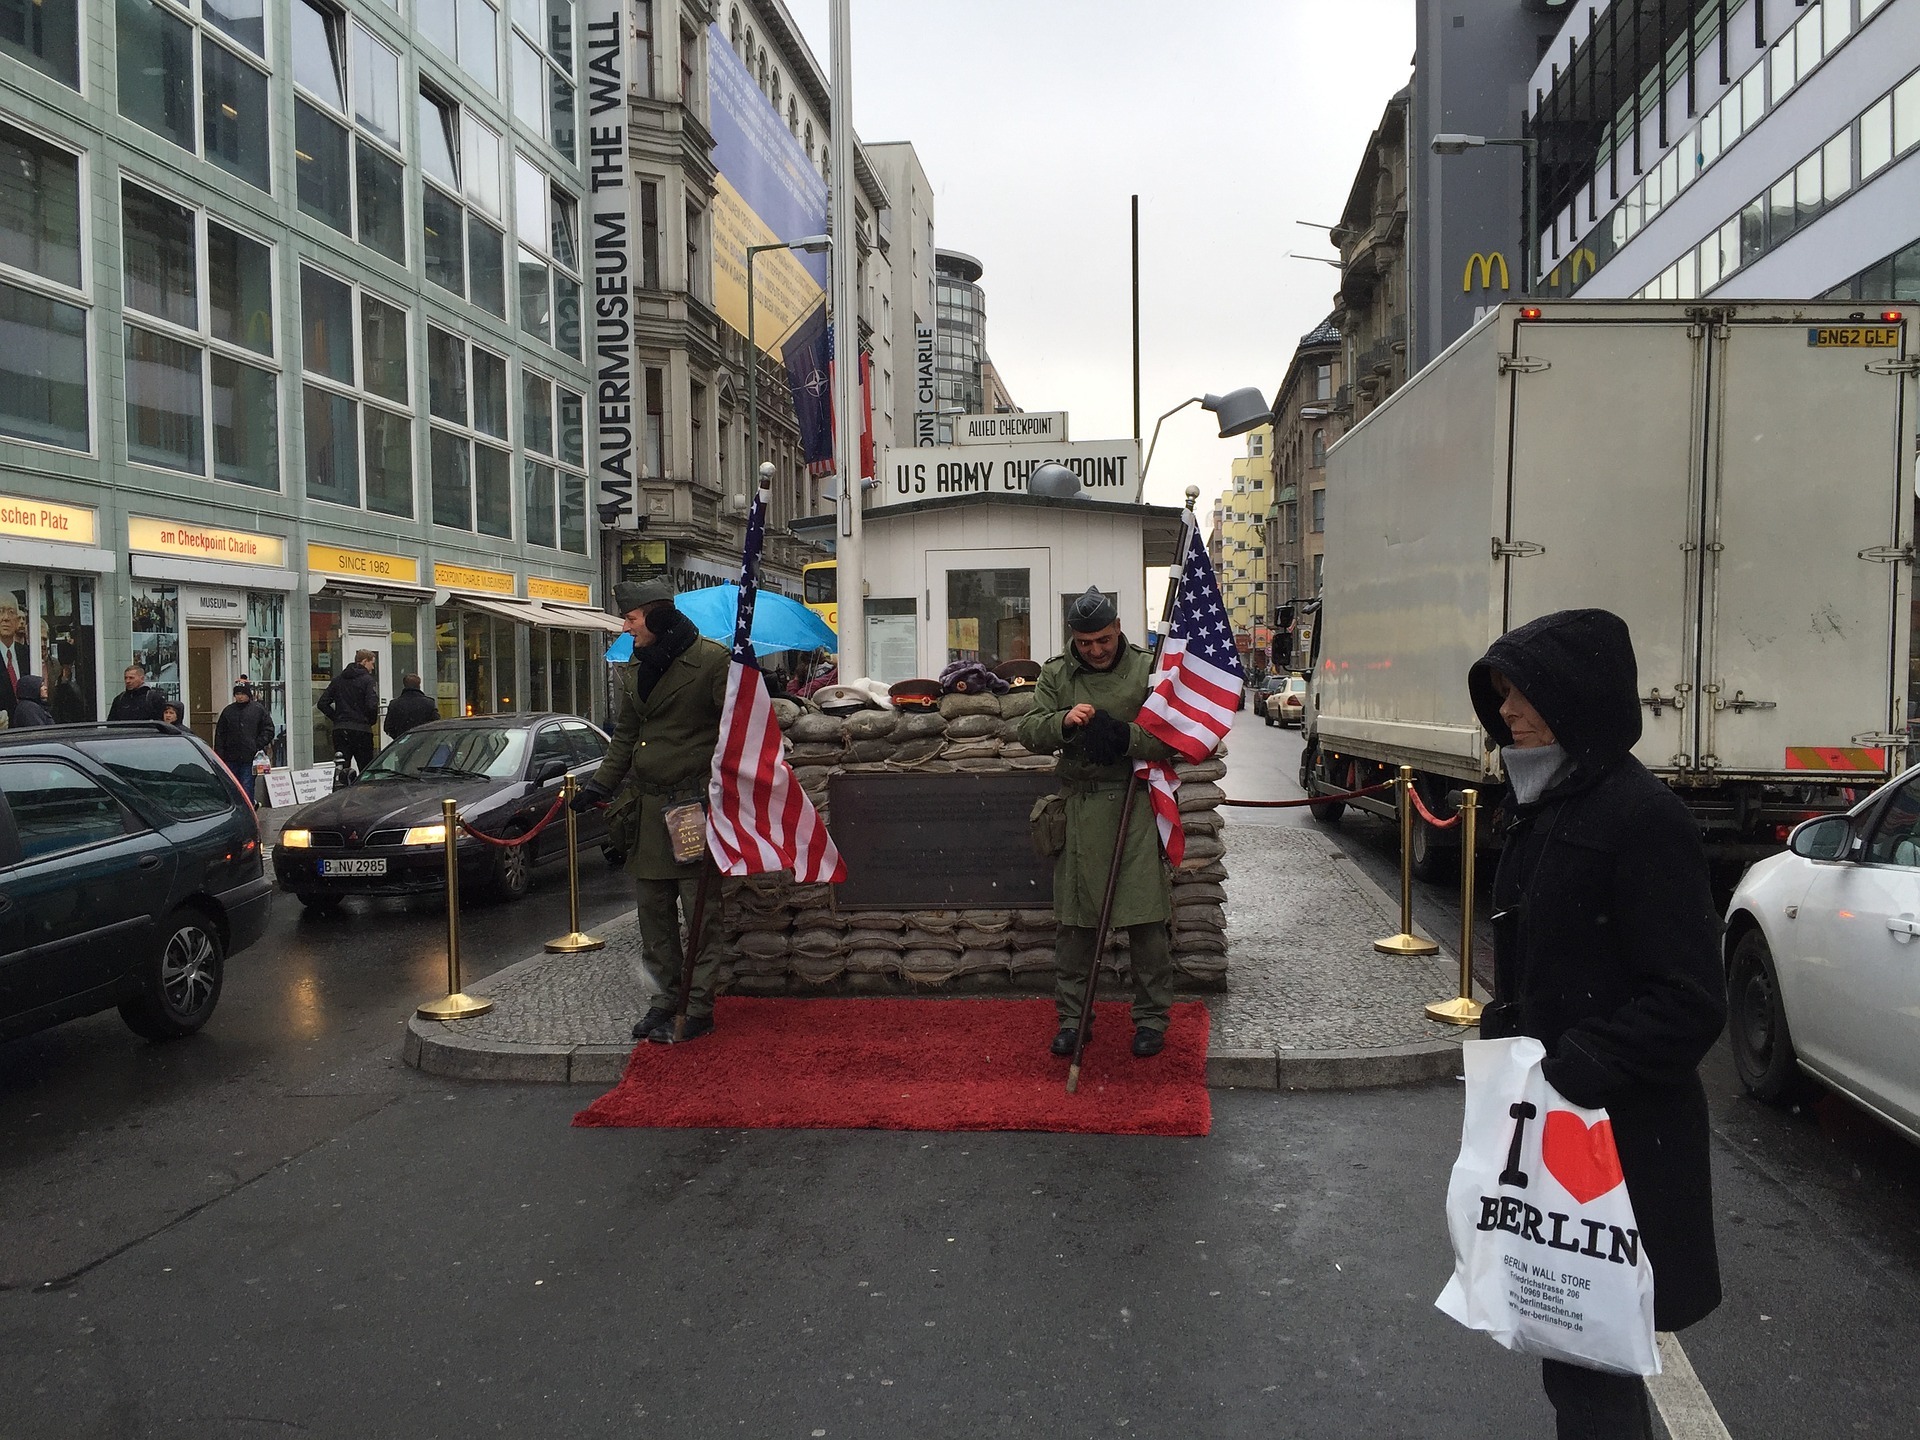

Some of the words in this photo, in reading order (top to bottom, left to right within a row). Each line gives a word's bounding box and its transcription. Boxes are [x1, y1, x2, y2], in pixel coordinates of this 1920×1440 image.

[587, 11, 622, 117] WALL
[590, 125, 623, 194] THE
[1817, 329, 1860, 345] GN62
[1864, 329, 1896, 345] GLF
[593, 212, 633, 514] MAUERMUSEUM
[917, 329, 934, 403] CHARLIE
[968, 419, 996, 437] ALLIED
[999, 417, 1053, 435] CHECKPOINT
[937, 461, 994, 493] ARMY
[1003, 456, 1128, 490] CHPOINT
[1, 507, 37, 526] schen
[40, 510, 69, 530] Platz
[160, 530, 175, 544] am
[178, 529, 227, 552] Checkpoint
[228, 537, 257, 555] Charlie
[338, 555, 367, 571] SINCE
[369, 560, 390, 574] 1962
[677, 567, 729, 592] CHECKPO
[200, 597, 227, 609] MUSEUM
[324, 860, 332, 872] B
[339, 860, 354, 872] NV
[356, 860, 385, 872] 2985
[1498, 1101, 1537, 1189] I
[1476, 1196, 1639, 1267] BERLIN
[1503, 1254, 1528, 1273] BERLIN
[1531, 1265, 1556, 1282] WALL
[1560, 1273, 1591, 1291] STORE
[1510, 1270, 1565, 1295] Friedrichstrasse
[1566, 1288, 1580, 1300] 206
[1509, 1289, 1583, 1321] wwberlintaschen.net
[1520, 1285, 1540, 1298] 10969
[1542, 1291, 1564, 1305] Berlin
[1508, 1300, 1583, 1332] wwder-berlinshop.de
